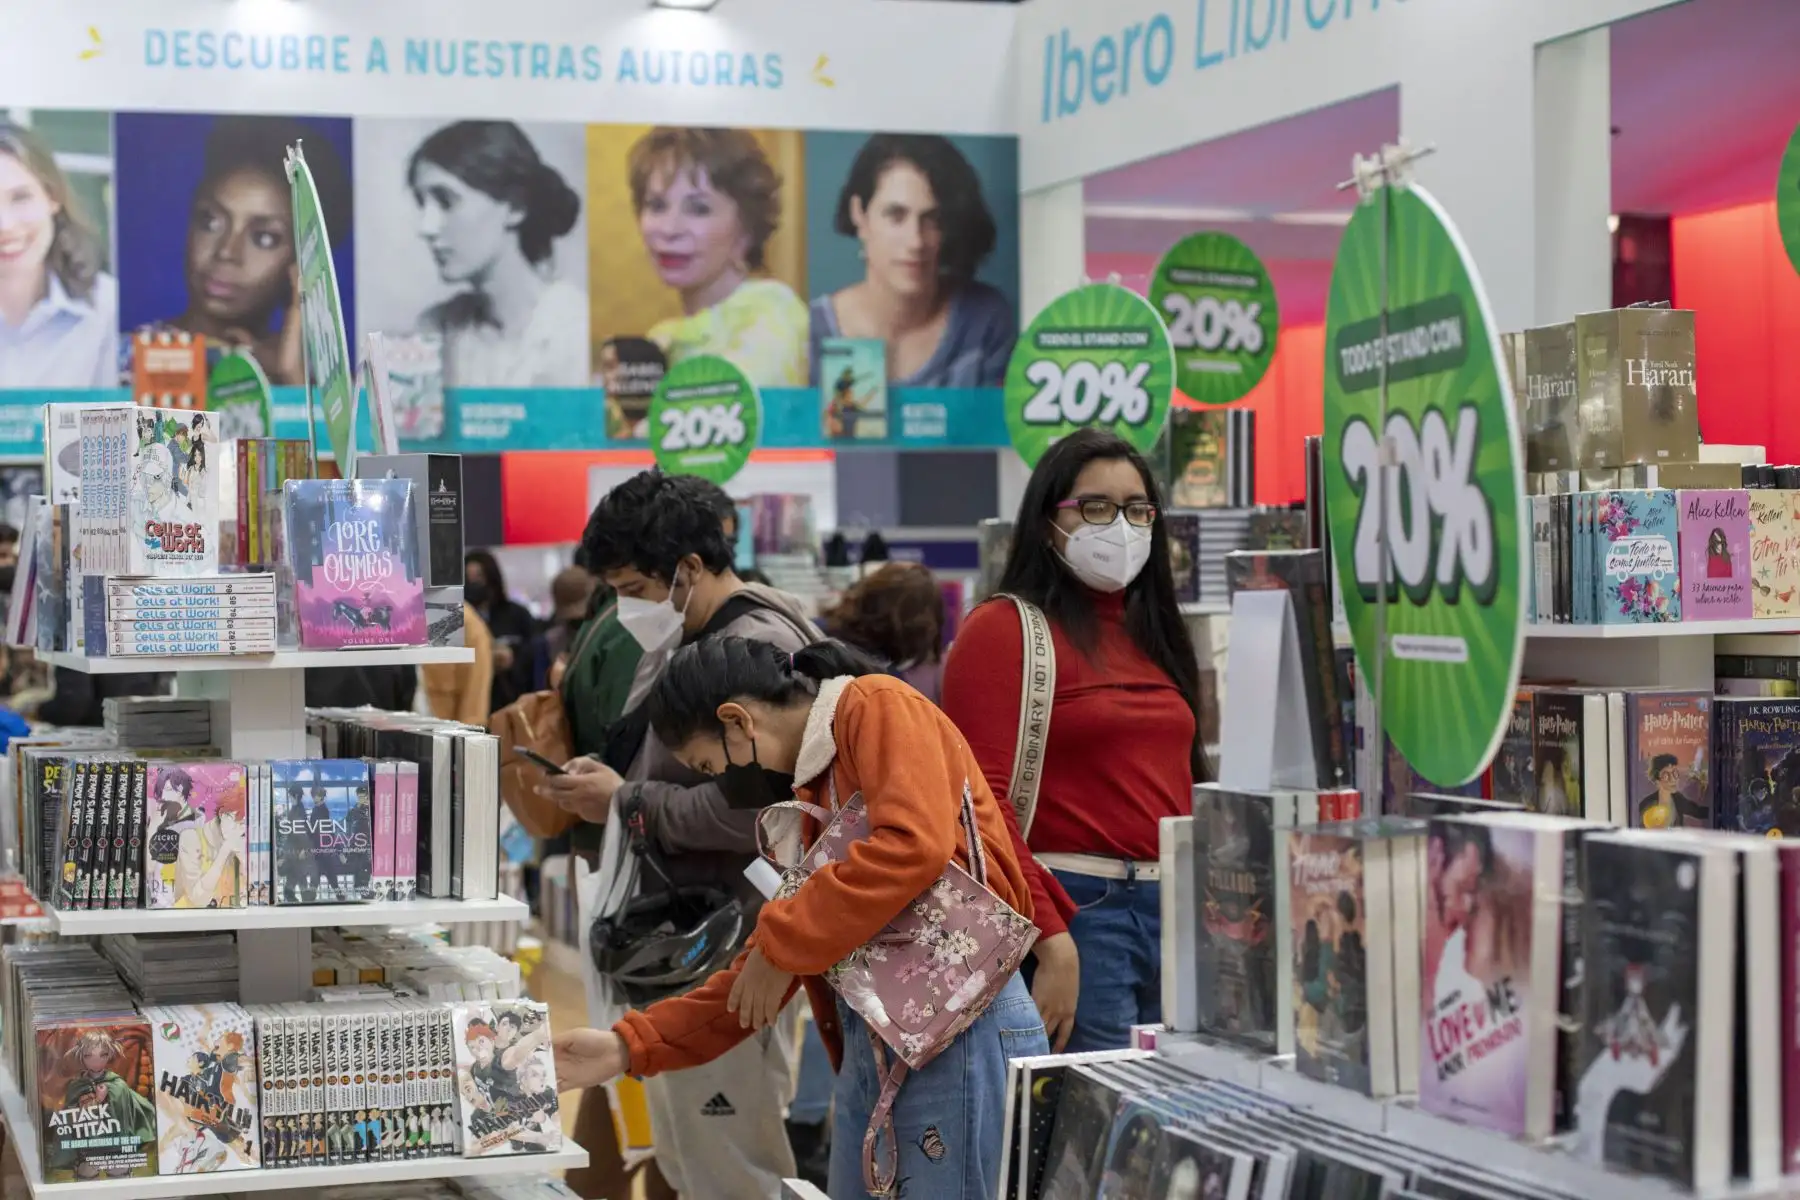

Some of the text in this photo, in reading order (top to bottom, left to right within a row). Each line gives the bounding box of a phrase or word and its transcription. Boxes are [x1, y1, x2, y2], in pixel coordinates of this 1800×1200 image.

[145, 29, 783, 89] DESCUBRE A NUESTRAS AUTORAS
[1042, 13, 1174, 122] Ibero
[1162, 293, 1263, 353] 20%
[1625, 358, 1693, 387] Harari
[1023, 360, 1151, 423] 20%
[1528, 372, 1576, 399] Harari
[659, 401, 747, 450] 20%
[120, 465, 127, 480] at
[1342, 404, 1494, 592] 20%
[1687, 497, 1746, 520] Alice Kellen
[1757, 508, 1783, 524] Kellen
[145, 519, 202, 538] Cells at
[328, 520, 381, 553] LORE
[161, 535, 205, 553] Work!
[1630, 541, 1650, 557] Todo
[324, 551, 394, 592] OLYMPUS
[1630, 553, 1661, 572] juntos
[165, 584, 179, 594] at
[181, 583, 216, 594] Work!
[136, 596, 220, 607] Cells at Work!
[136, 607, 220, 619] Cells at Work!
[133, 619, 217, 631] Cells at Work!
[135, 630, 218, 642] Cells at Work!
[136, 641, 219, 653] Cells at Work!
[1034, 661, 1047, 693] NOT
[1643, 709, 1705, 735] Harry Potter
[1749, 705, 1800, 716] J.K. ROWLING
[1539, 714, 1577, 737] Harry Potter
[1739, 718, 1773, 734] HARRY
[1022, 699, 1045, 781] ORDINARY
[72, 773, 85, 825] DEMON SLAYER
[85, 773, 98, 825] DEMON SLAYER
[100, 773, 113, 825] DEMON SLAYER
[117, 773, 128, 825] DEMON SLAYER
[132, 773, 144, 825] DEMON SLAYER
[1015, 787, 1031, 817] NOT
[278, 818, 347, 835] SEVEN
[320, 832, 368, 848] DAYS
[1428, 976, 1519, 1062] LOVE ME
[48, 1103, 111, 1128] ATTACK
[56, 1118, 121, 1138] on TITAN
[61, 1141, 70, 1149] THE
[121, 1145, 133, 1153] PART
